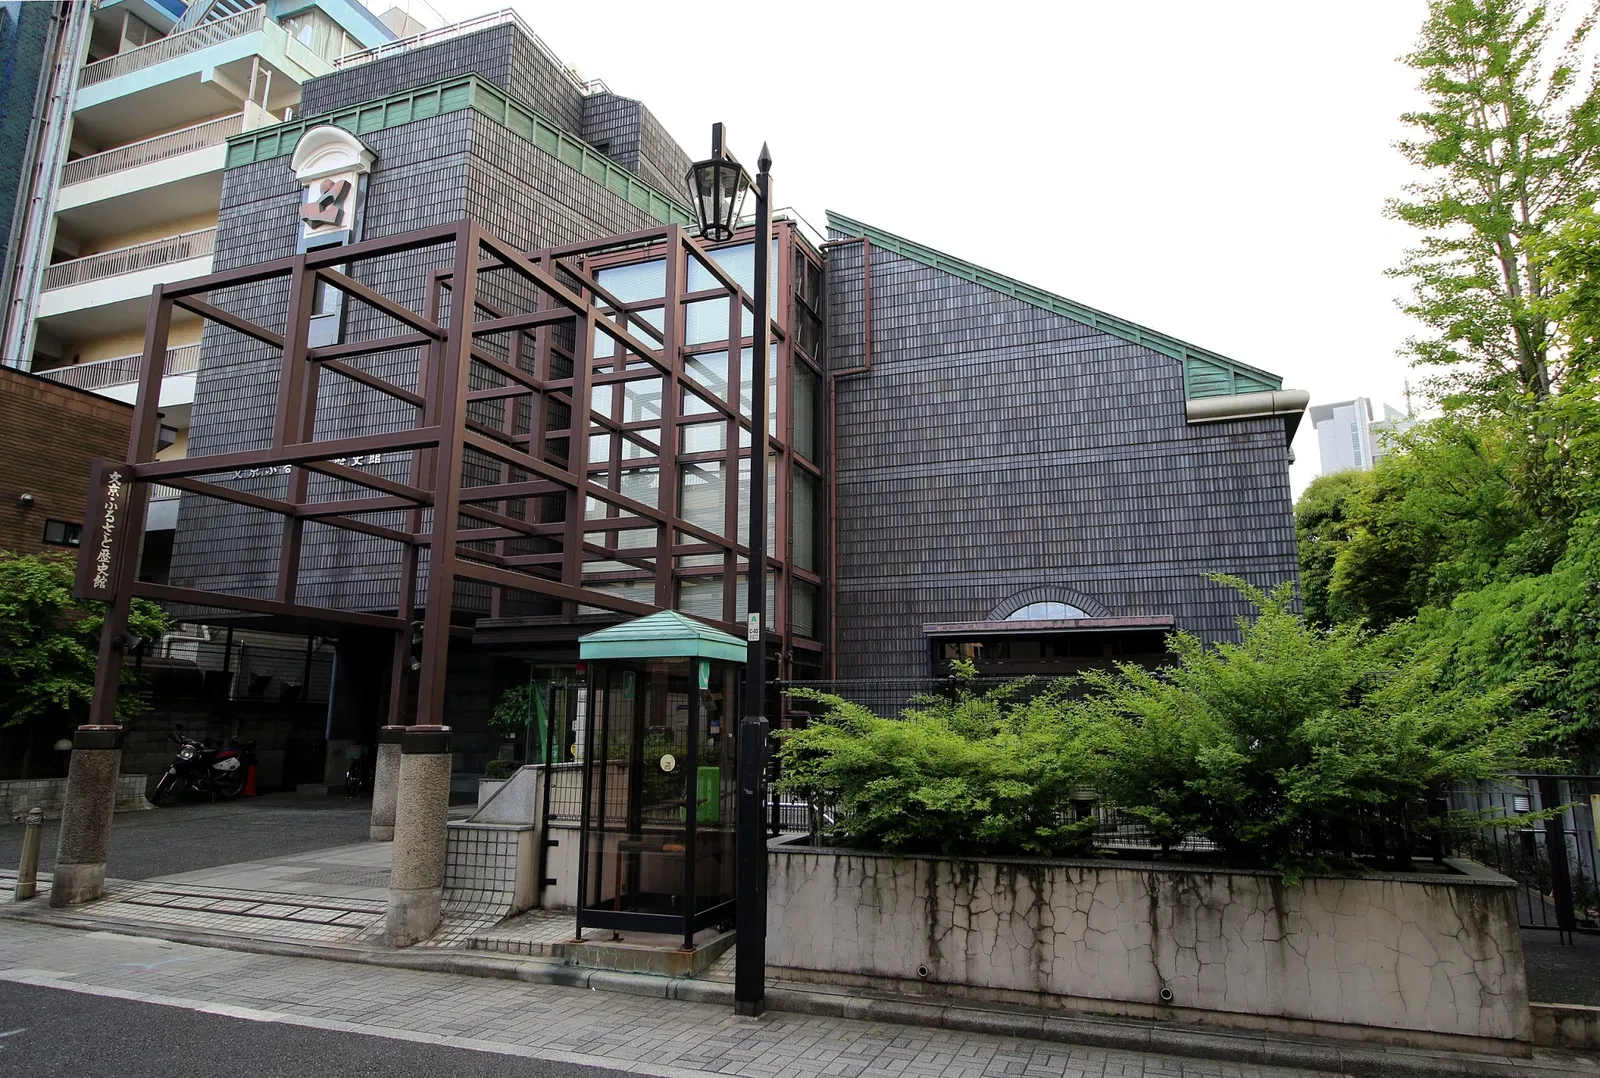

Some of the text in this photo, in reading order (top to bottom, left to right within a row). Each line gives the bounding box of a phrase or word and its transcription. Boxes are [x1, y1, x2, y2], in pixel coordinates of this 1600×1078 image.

[93, 471, 122, 589] 文京ふるさと歴史館
